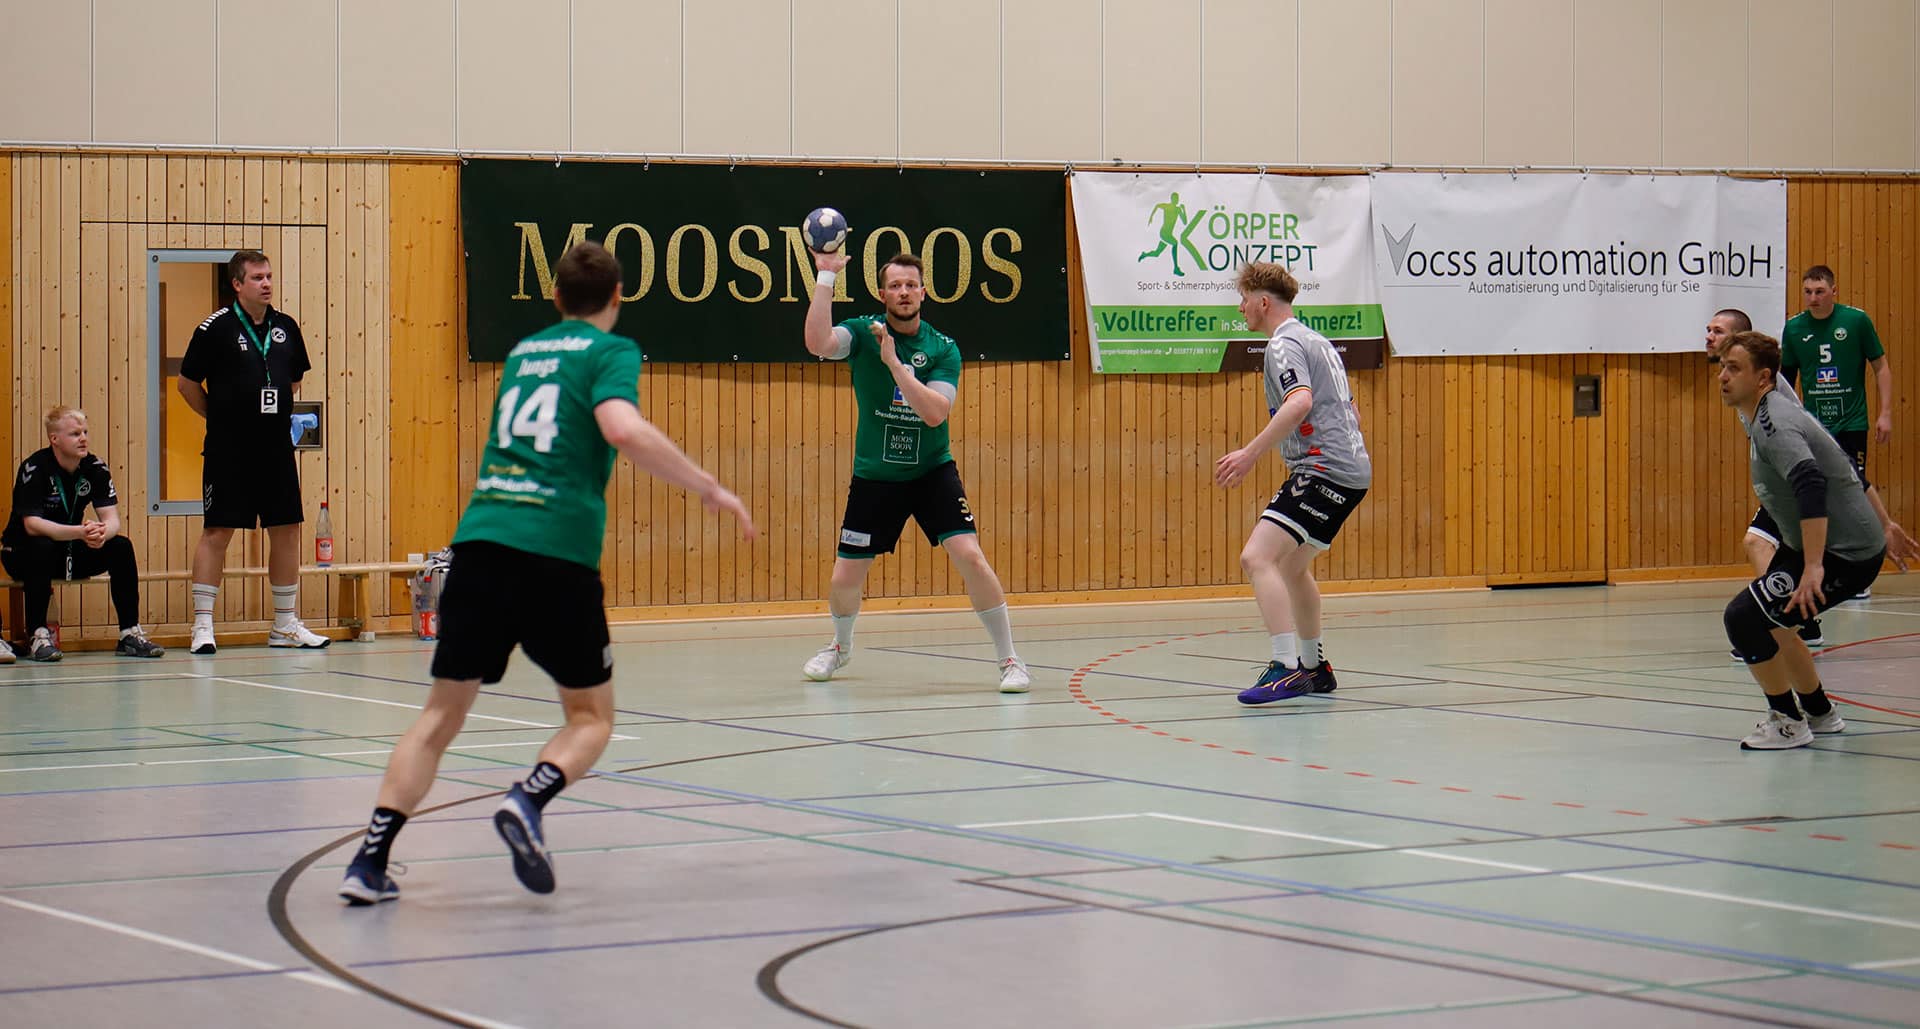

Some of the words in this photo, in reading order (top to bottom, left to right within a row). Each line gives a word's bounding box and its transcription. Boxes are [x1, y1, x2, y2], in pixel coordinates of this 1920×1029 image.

[1488, 240, 1667, 277] automation
[1679, 241, 1772, 278] GmbH
[1137, 281, 1163, 292] Sport-
[1164, 281, 1171, 290] &
[1172, 281, 1236, 292] Schmerzphysiot
[1298, 281, 1320, 291] rapie
[1468, 280, 1559, 297] Automatisierung
[1562, 280, 1586, 293] und
[1589, 279, 1658, 296] Digitalisierung
[1662, 279, 1677, 293] für
[1681, 279, 1700, 293] Sie
[1102, 310, 1217, 332] Volltreffer
[1221, 320, 1230, 332] in
[1232, 320, 1249, 332] Sac
[1294, 310, 1362, 331] hmerz!
[1819, 343, 1832, 364] 5
[264, 390, 276, 405] B
[497, 383, 560, 453] 14
[1856, 451, 1864, 465] 5
